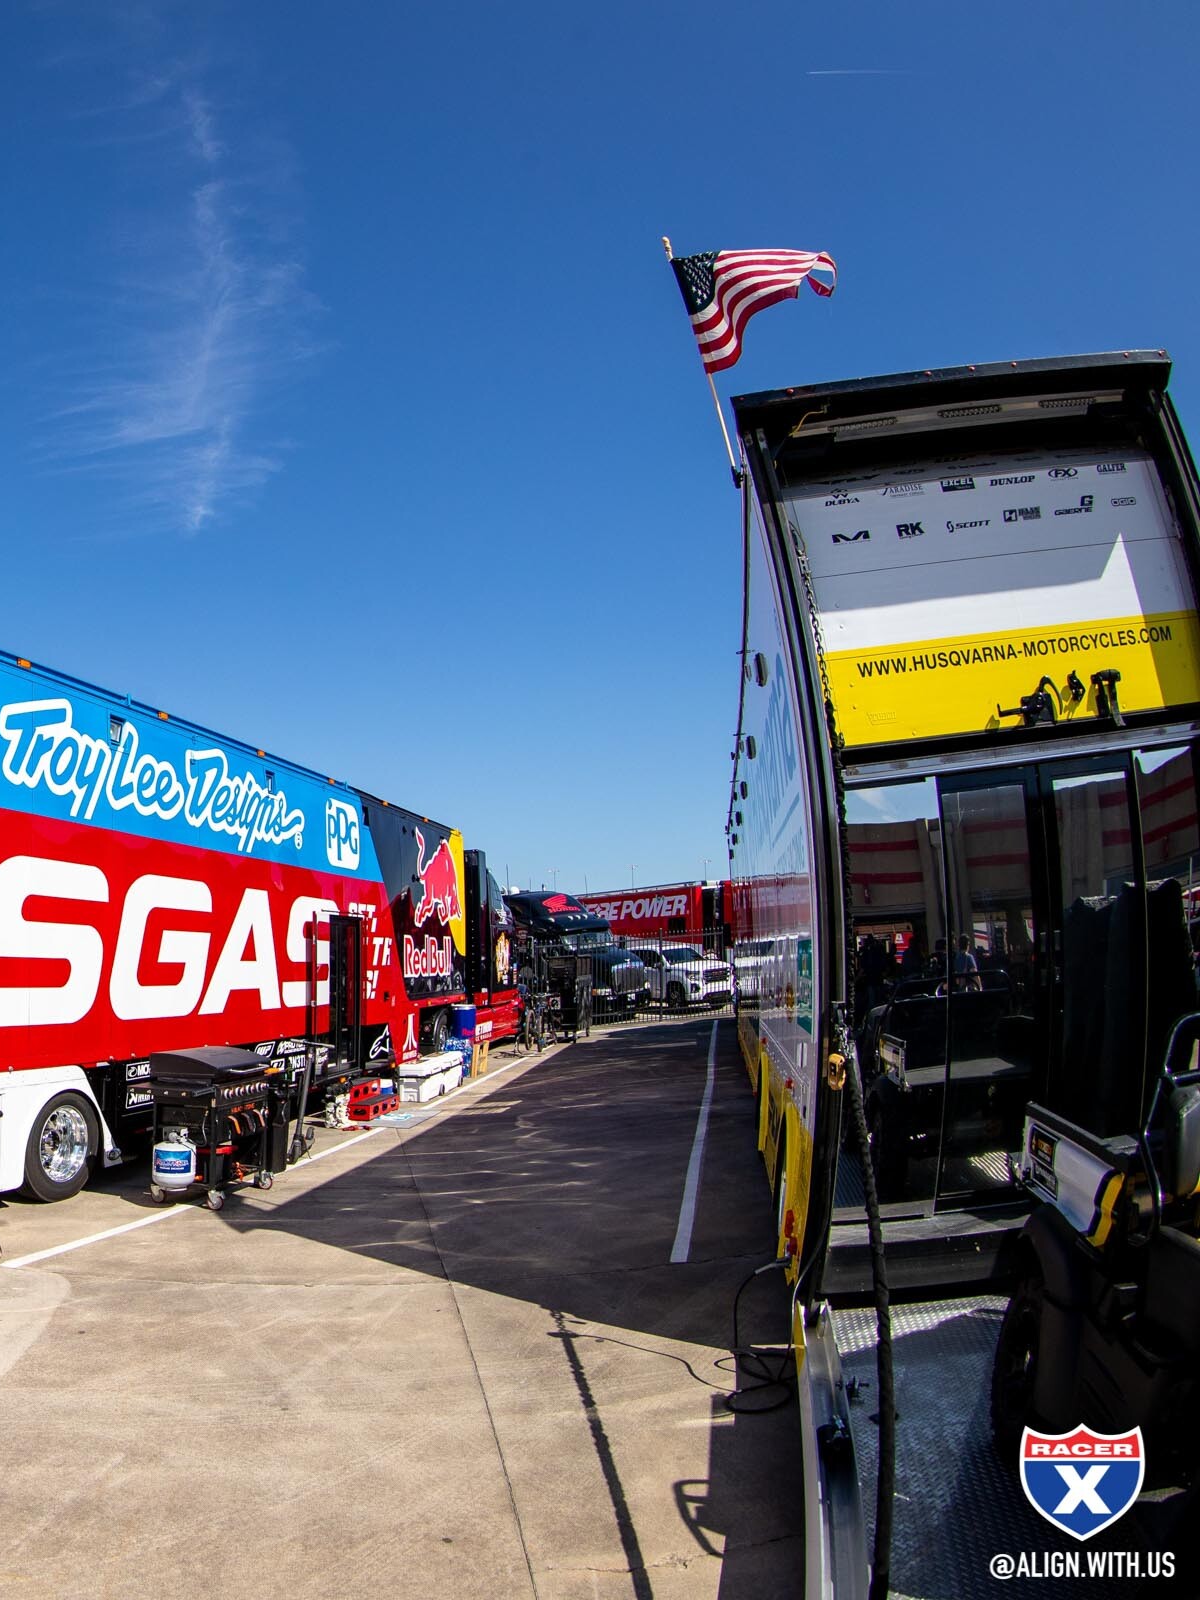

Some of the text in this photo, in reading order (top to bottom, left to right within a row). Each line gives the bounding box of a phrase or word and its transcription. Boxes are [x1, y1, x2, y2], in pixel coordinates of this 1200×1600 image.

[942, 478, 973, 488] EXCEL
[990, 475, 1036, 487] DUNLOP
[825, 497, 860, 507] DUBYA
[896, 522, 925, 538] RK
[955, 519, 991, 530] SCOTT
[857, 625, 1173, 678] WWW.HUSQVARNA-MOTORCYCLES.COM
[105, 721, 185, 820] Lee
[184, 748, 305, 853] Designs
[327, 802, 359, 863] PPG
[547, 904, 581, 914] HONDA
[620, 894, 688, 920] POWER
[403, 934, 430, 978] Red
[429, 936, 452, 976] Bull
